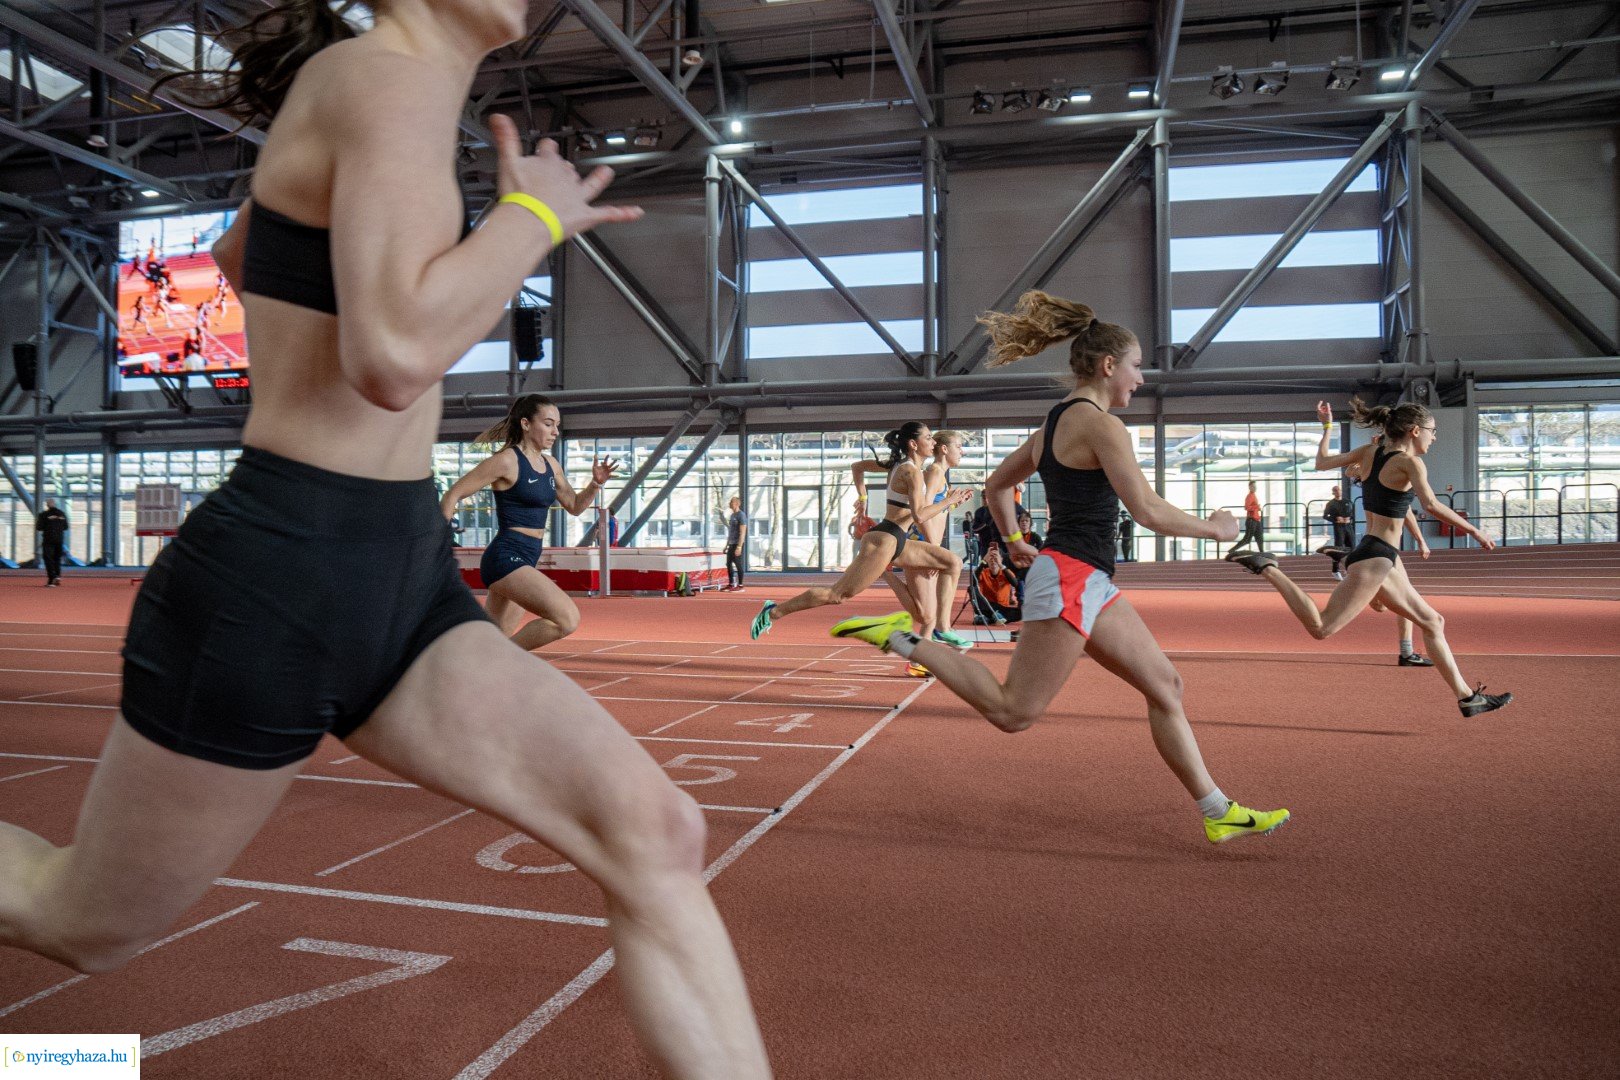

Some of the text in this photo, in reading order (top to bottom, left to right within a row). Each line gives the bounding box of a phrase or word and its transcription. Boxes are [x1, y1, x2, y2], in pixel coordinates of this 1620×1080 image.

[789, 684, 865, 699] 3
[734, 712, 815, 733] 4
[662, 753, 762, 786] 5
[140, 937, 454, 1059] 7
